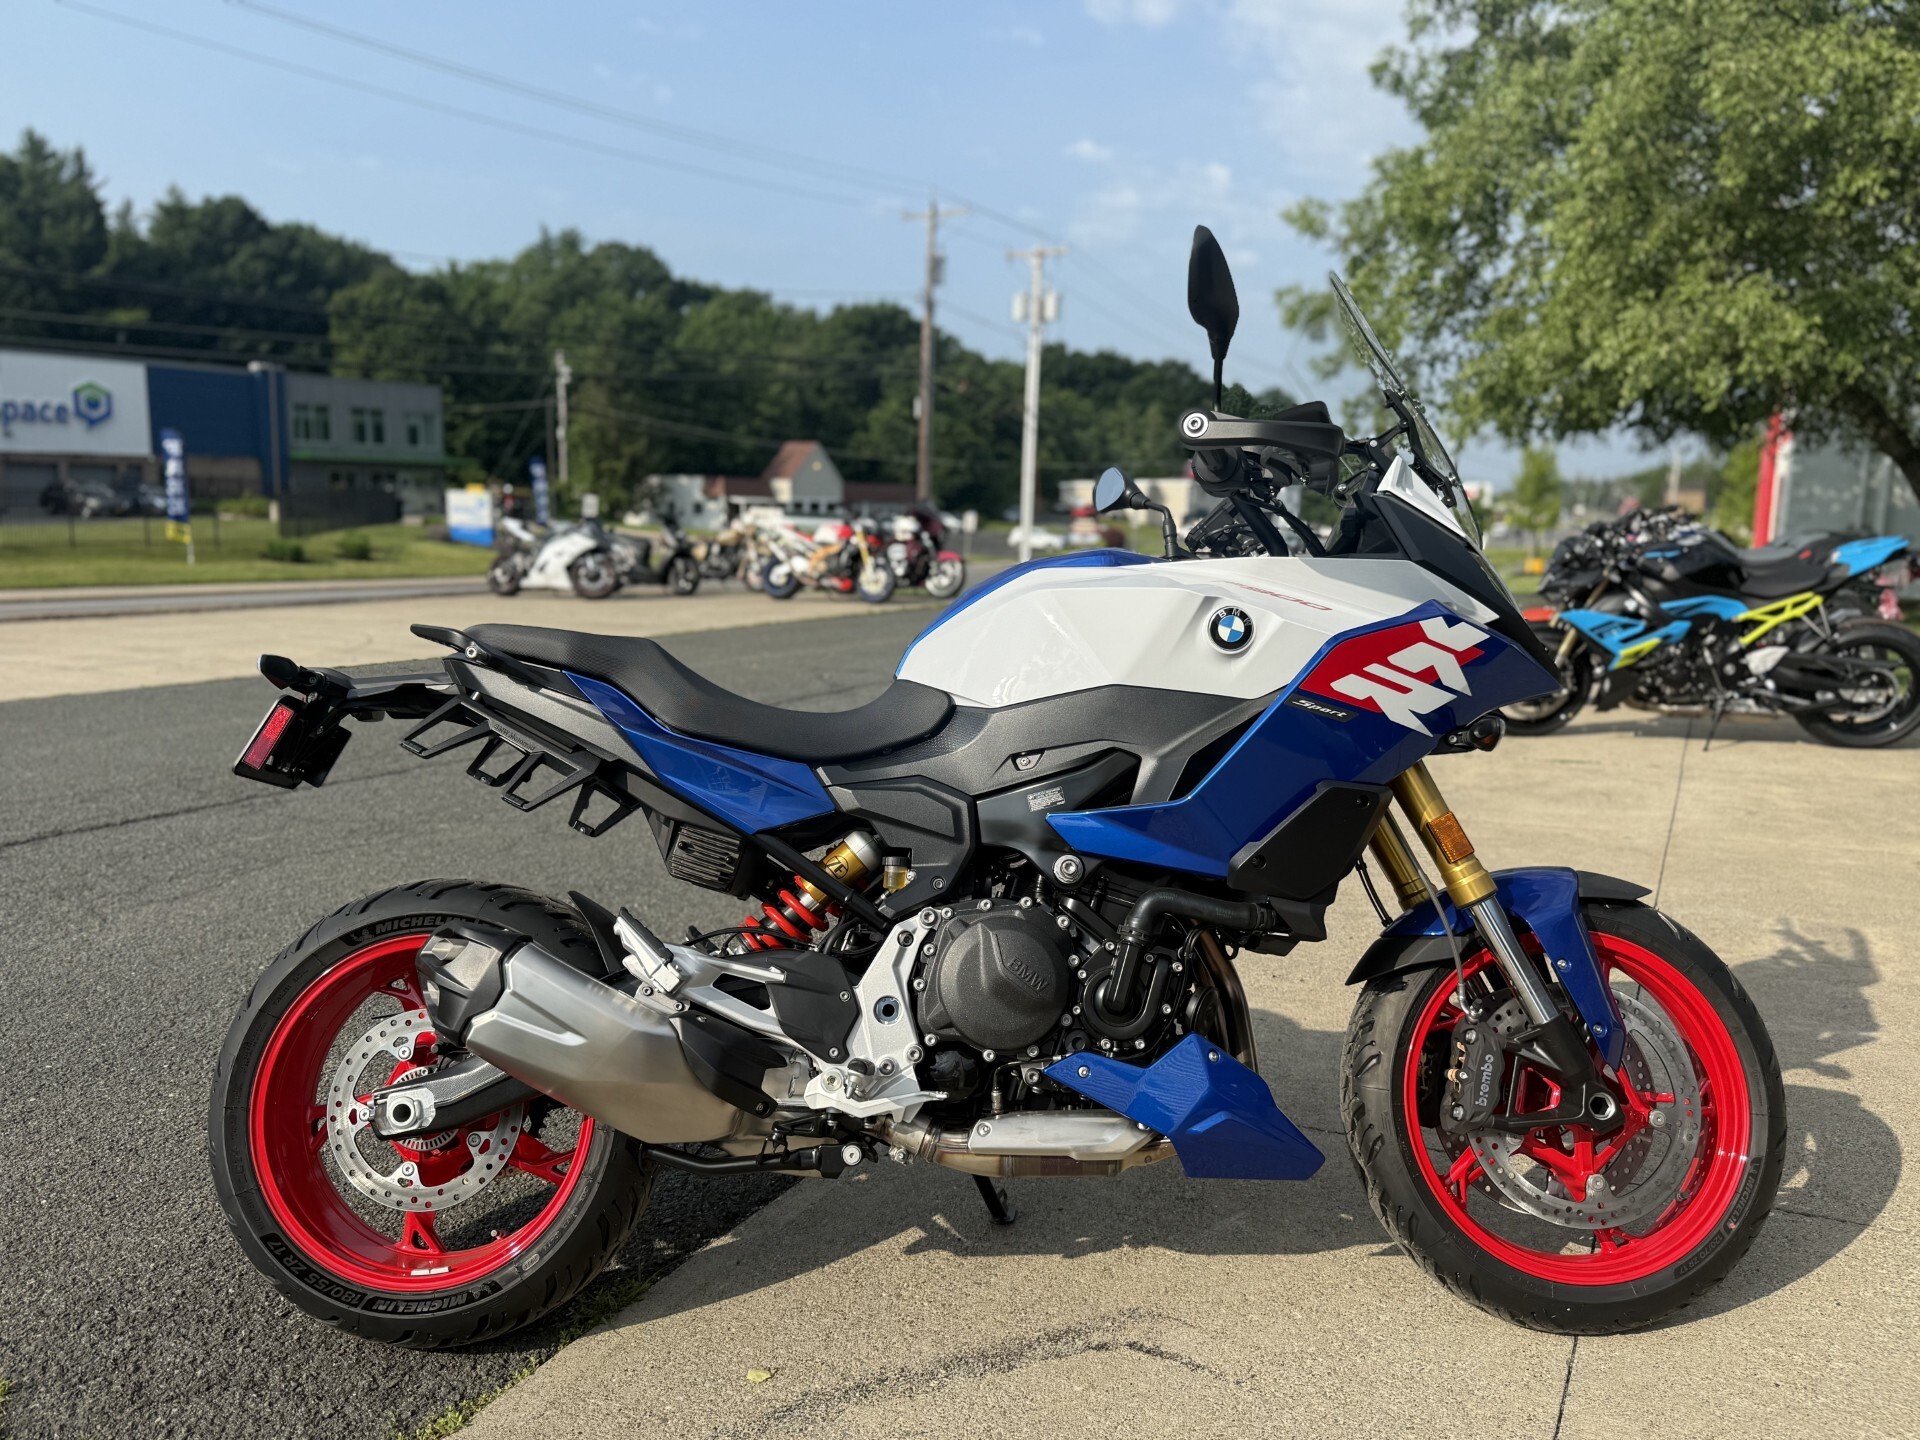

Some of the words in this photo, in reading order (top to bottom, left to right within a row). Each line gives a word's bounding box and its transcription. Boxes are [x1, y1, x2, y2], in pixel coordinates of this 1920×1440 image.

[1292, 699, 1348, 718] Sport
[826, 856, 849, 879] ZF
[375, 914, 464, 935] MICHEL
[1007, 956, 1050, 992] BMW
[1475, 1054, 1494, 1107] brembo
[267, 1240, 282, 1256] 17
[282, 1252, 307, 1275] ZR
[303, 1271, 363, 1308] 180/55
[372, 1292, 468, 1313] MICHELIN
